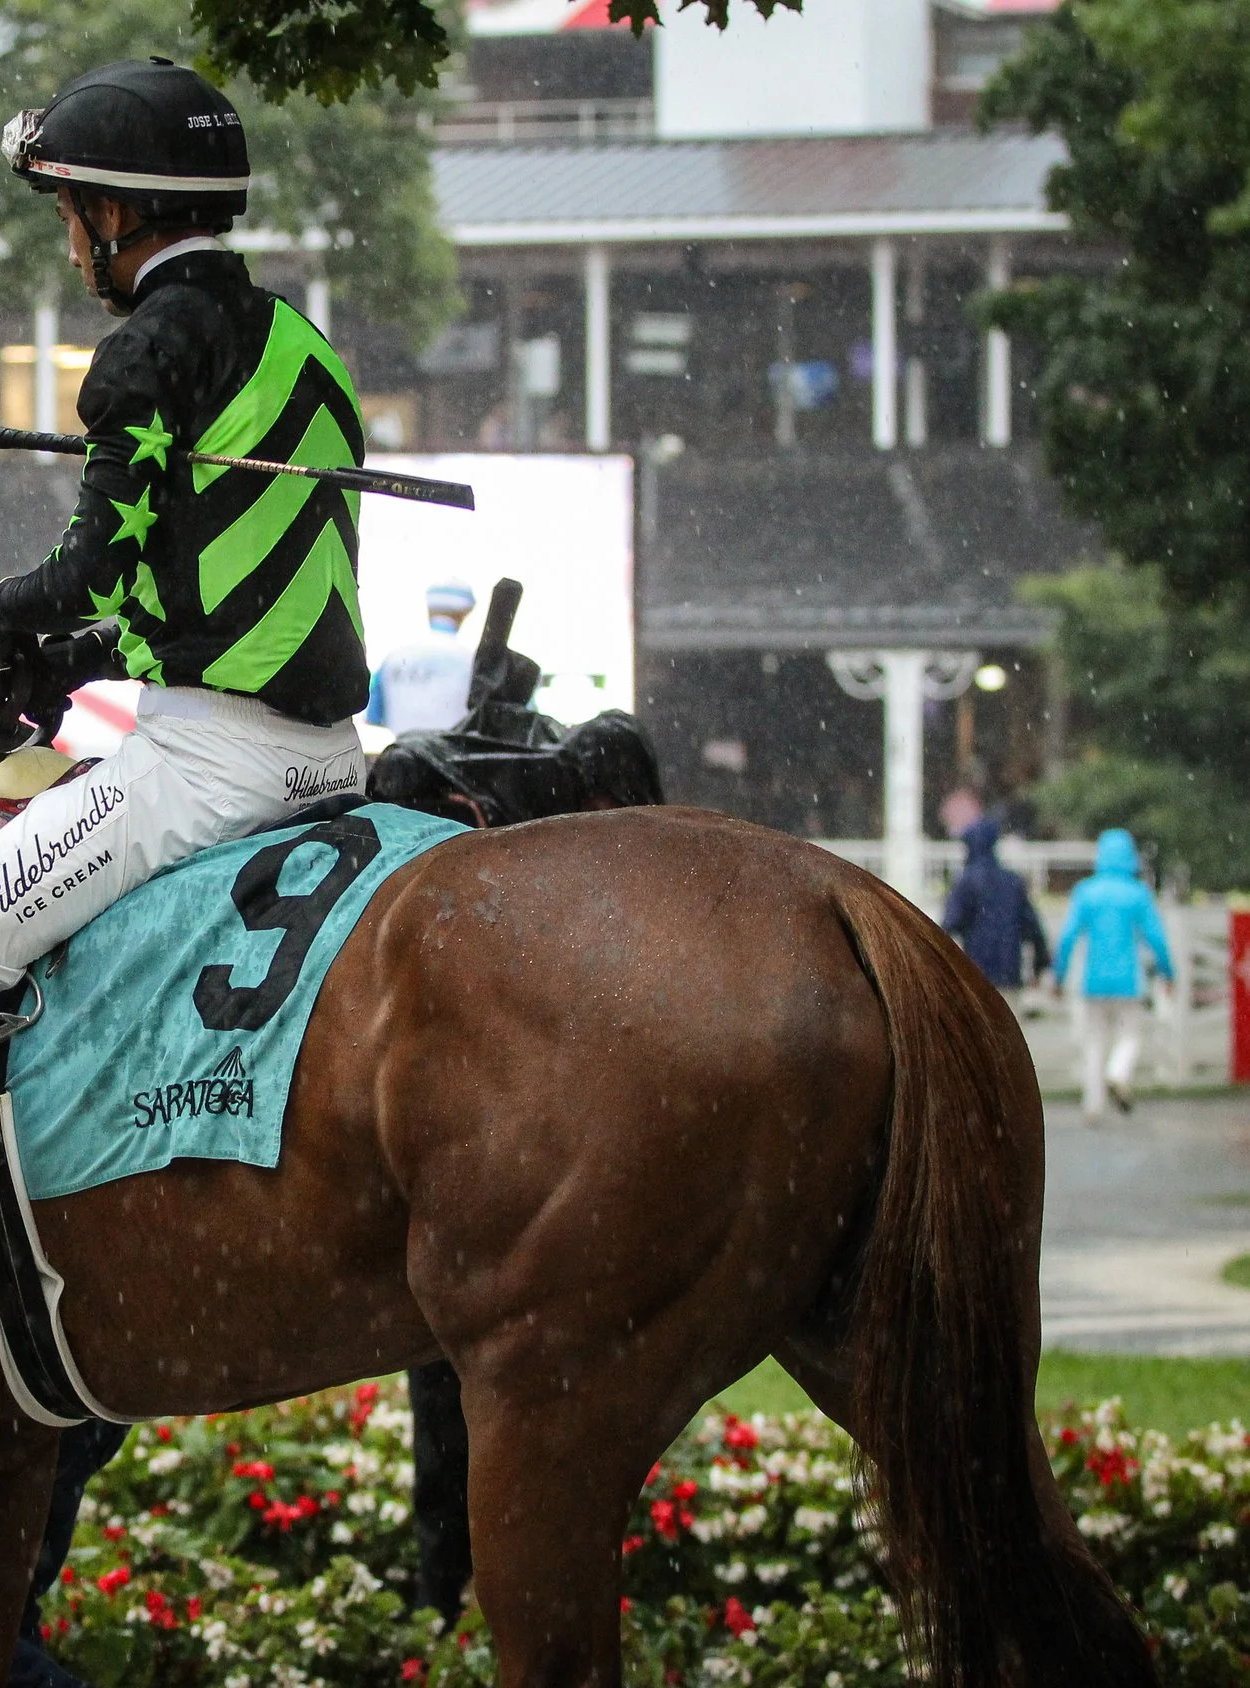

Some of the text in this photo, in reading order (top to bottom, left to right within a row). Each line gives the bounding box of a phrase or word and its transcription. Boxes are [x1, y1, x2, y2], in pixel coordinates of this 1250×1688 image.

[187, 114, 212, 129] JOSE
[15, 850, 114, 924] ICE CREAM
[192, 813, 383, 1032] 9
[133, 1078, 254, 1129] SARATOGA
